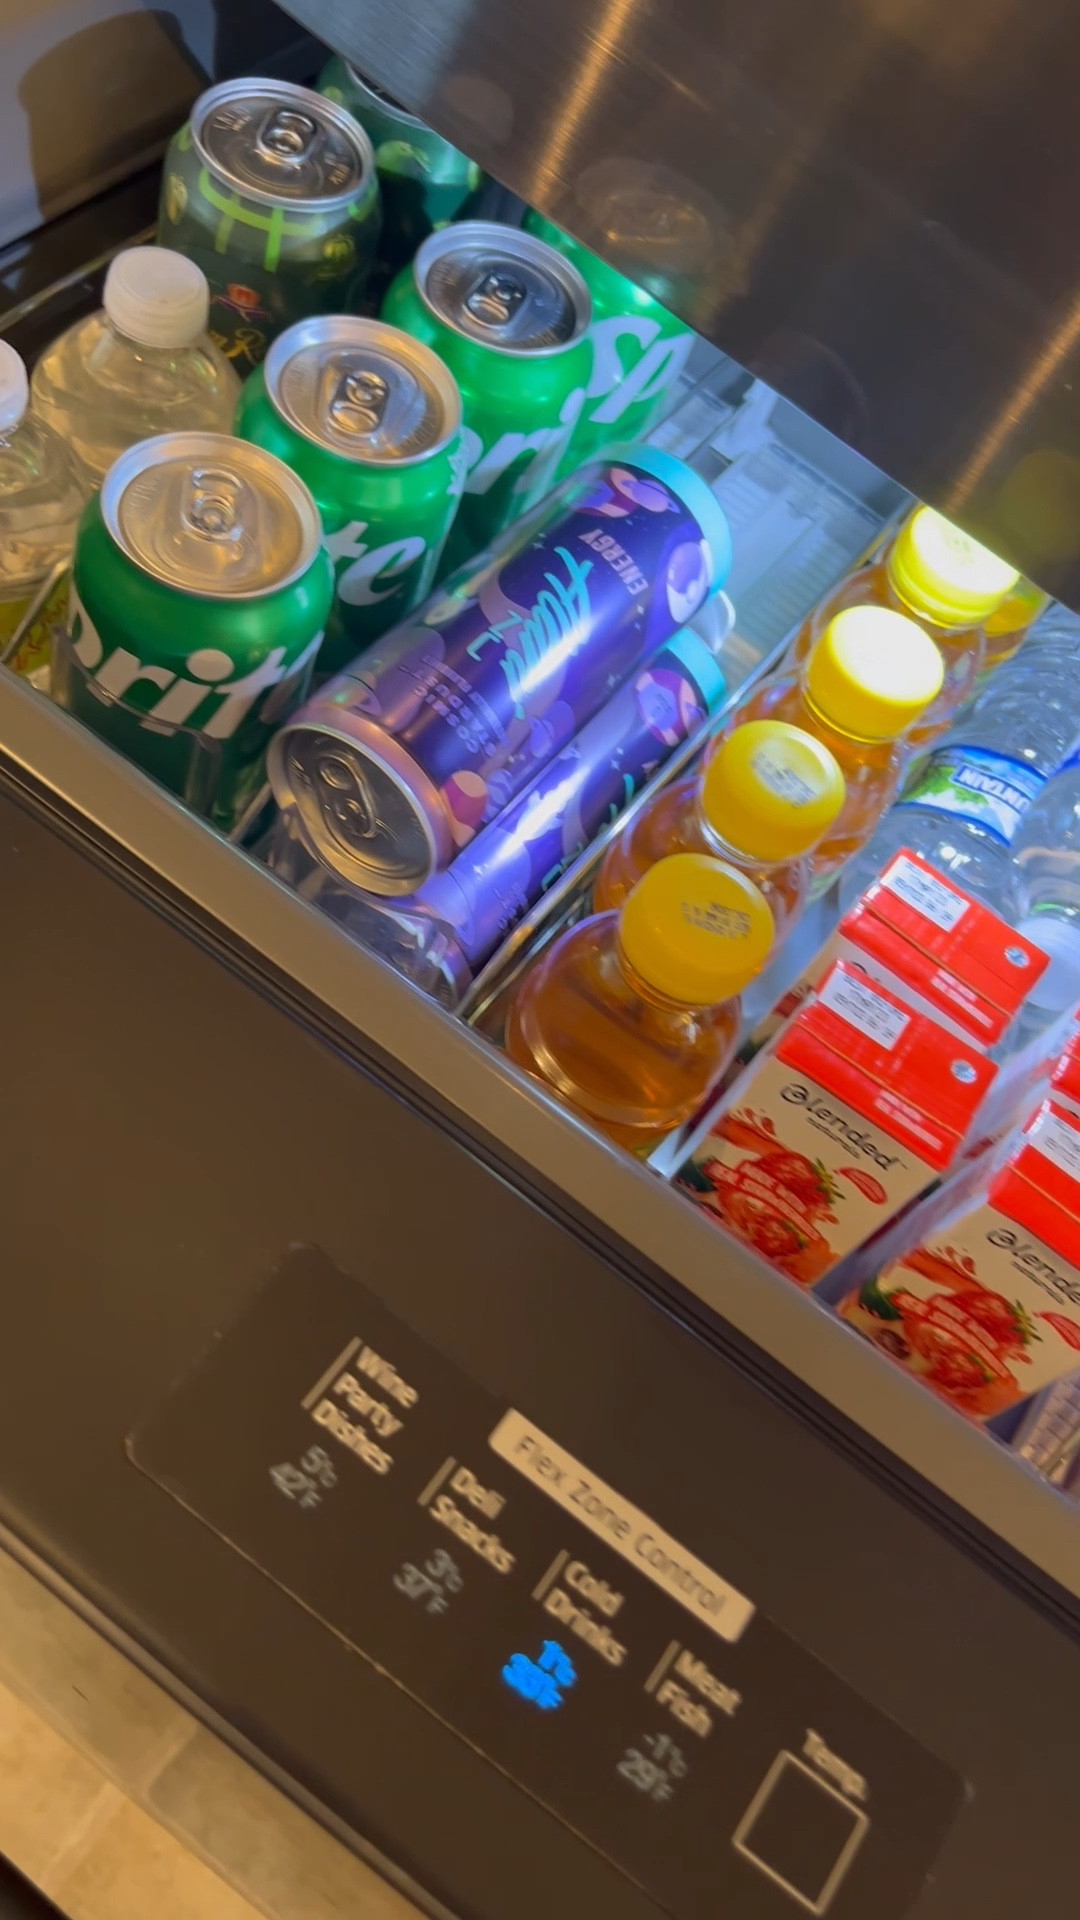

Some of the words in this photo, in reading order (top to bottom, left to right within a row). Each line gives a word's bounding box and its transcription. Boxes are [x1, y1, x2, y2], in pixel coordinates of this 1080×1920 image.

[577, 528, 649, 597] ENERGY
[412, 683, 481, 755] COSMIC
[779, 1082, 902, 1172] Blended
[986, 1227, 1080, 1304] Blende
[332, 1371, 404, 1438] Party
[356, 1345, 419, 1408] Wine
[311, 1398, 394, 1476] Dishes
[449, 1465, 507, 1520] Deli
[513, 1434, 567, 1490] Flex
[567, 1480, 632, 1542] Zone
[633, 1531, 728, 1617] Control
[429, 1494, 517, 1575] Snacks
[563, 1560, 625, 1618] Cold
[543, 1587, 628, 1668] Drinks
